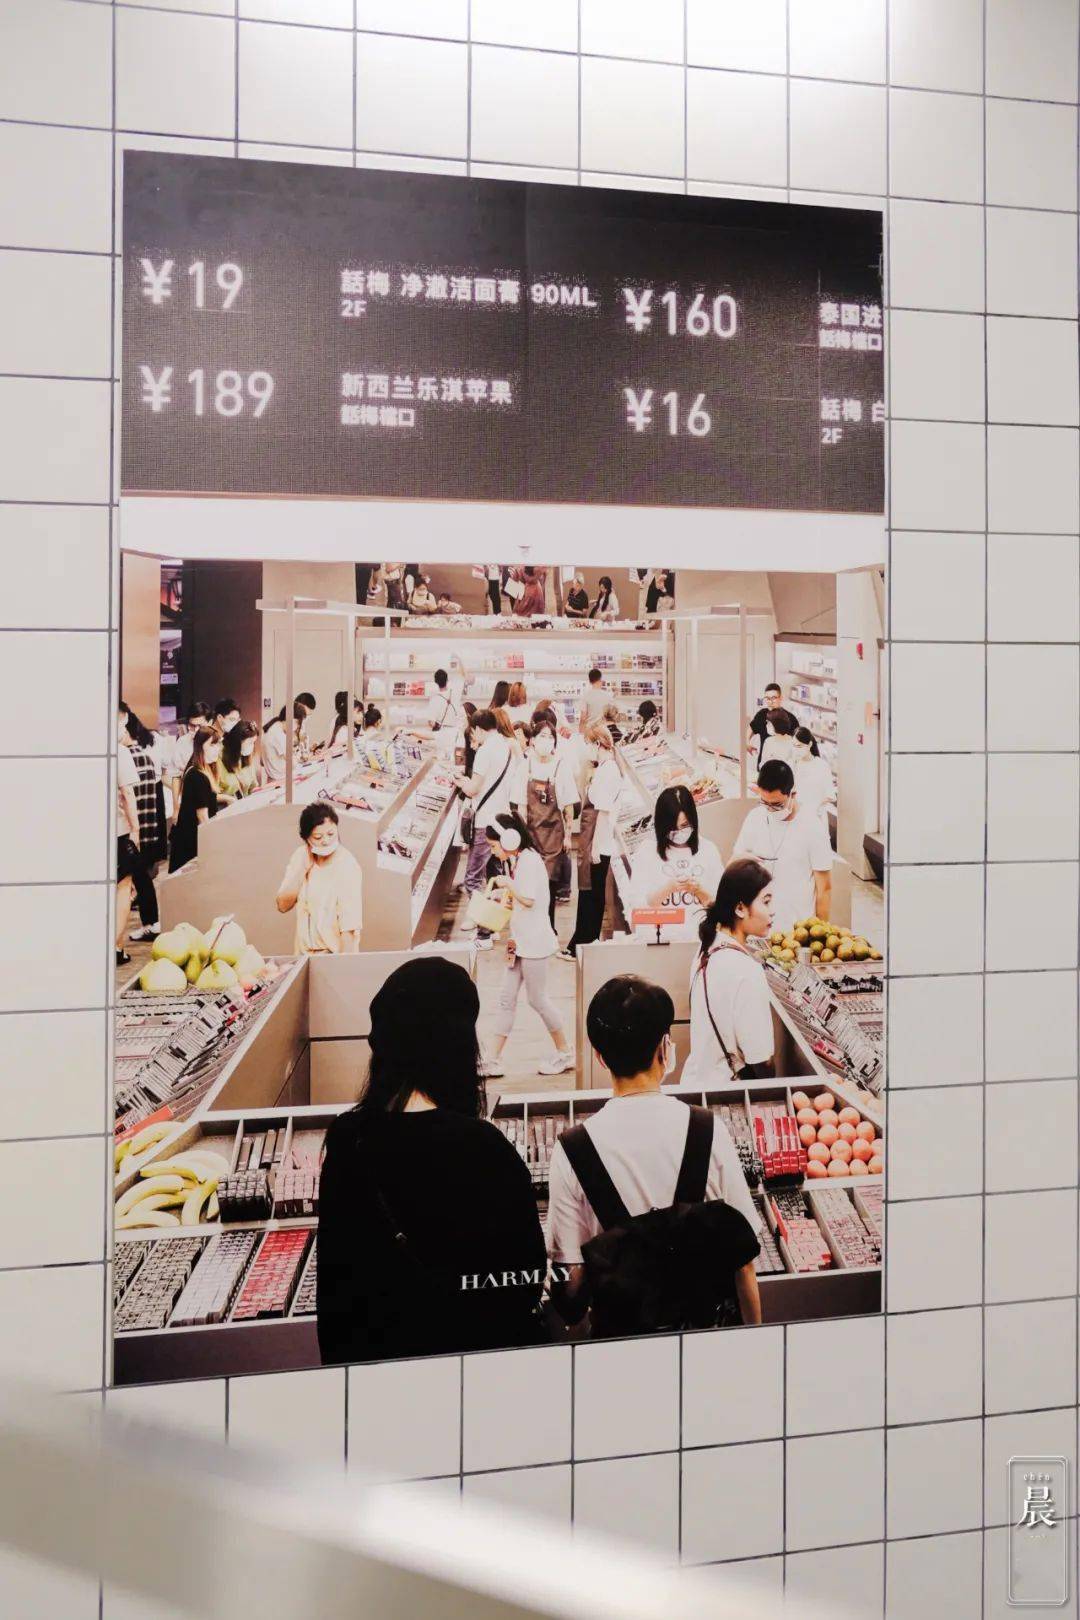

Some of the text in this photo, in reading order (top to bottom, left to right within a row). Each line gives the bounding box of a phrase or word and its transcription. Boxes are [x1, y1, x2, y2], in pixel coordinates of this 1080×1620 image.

[341, 299, 367, 317] 2F
[531, 283, 597, 307] 90ML
[623, 288, 738, 339] ¥160
[139, 365, 275, 417] ¥189
[341, 372, 512, 405] 新西兰乐淇苹果
[624, 388, 712, 437] ¥16
[821, 428, 843, 444] 2F
[461, 1266, 572, 1290] HARMAY
